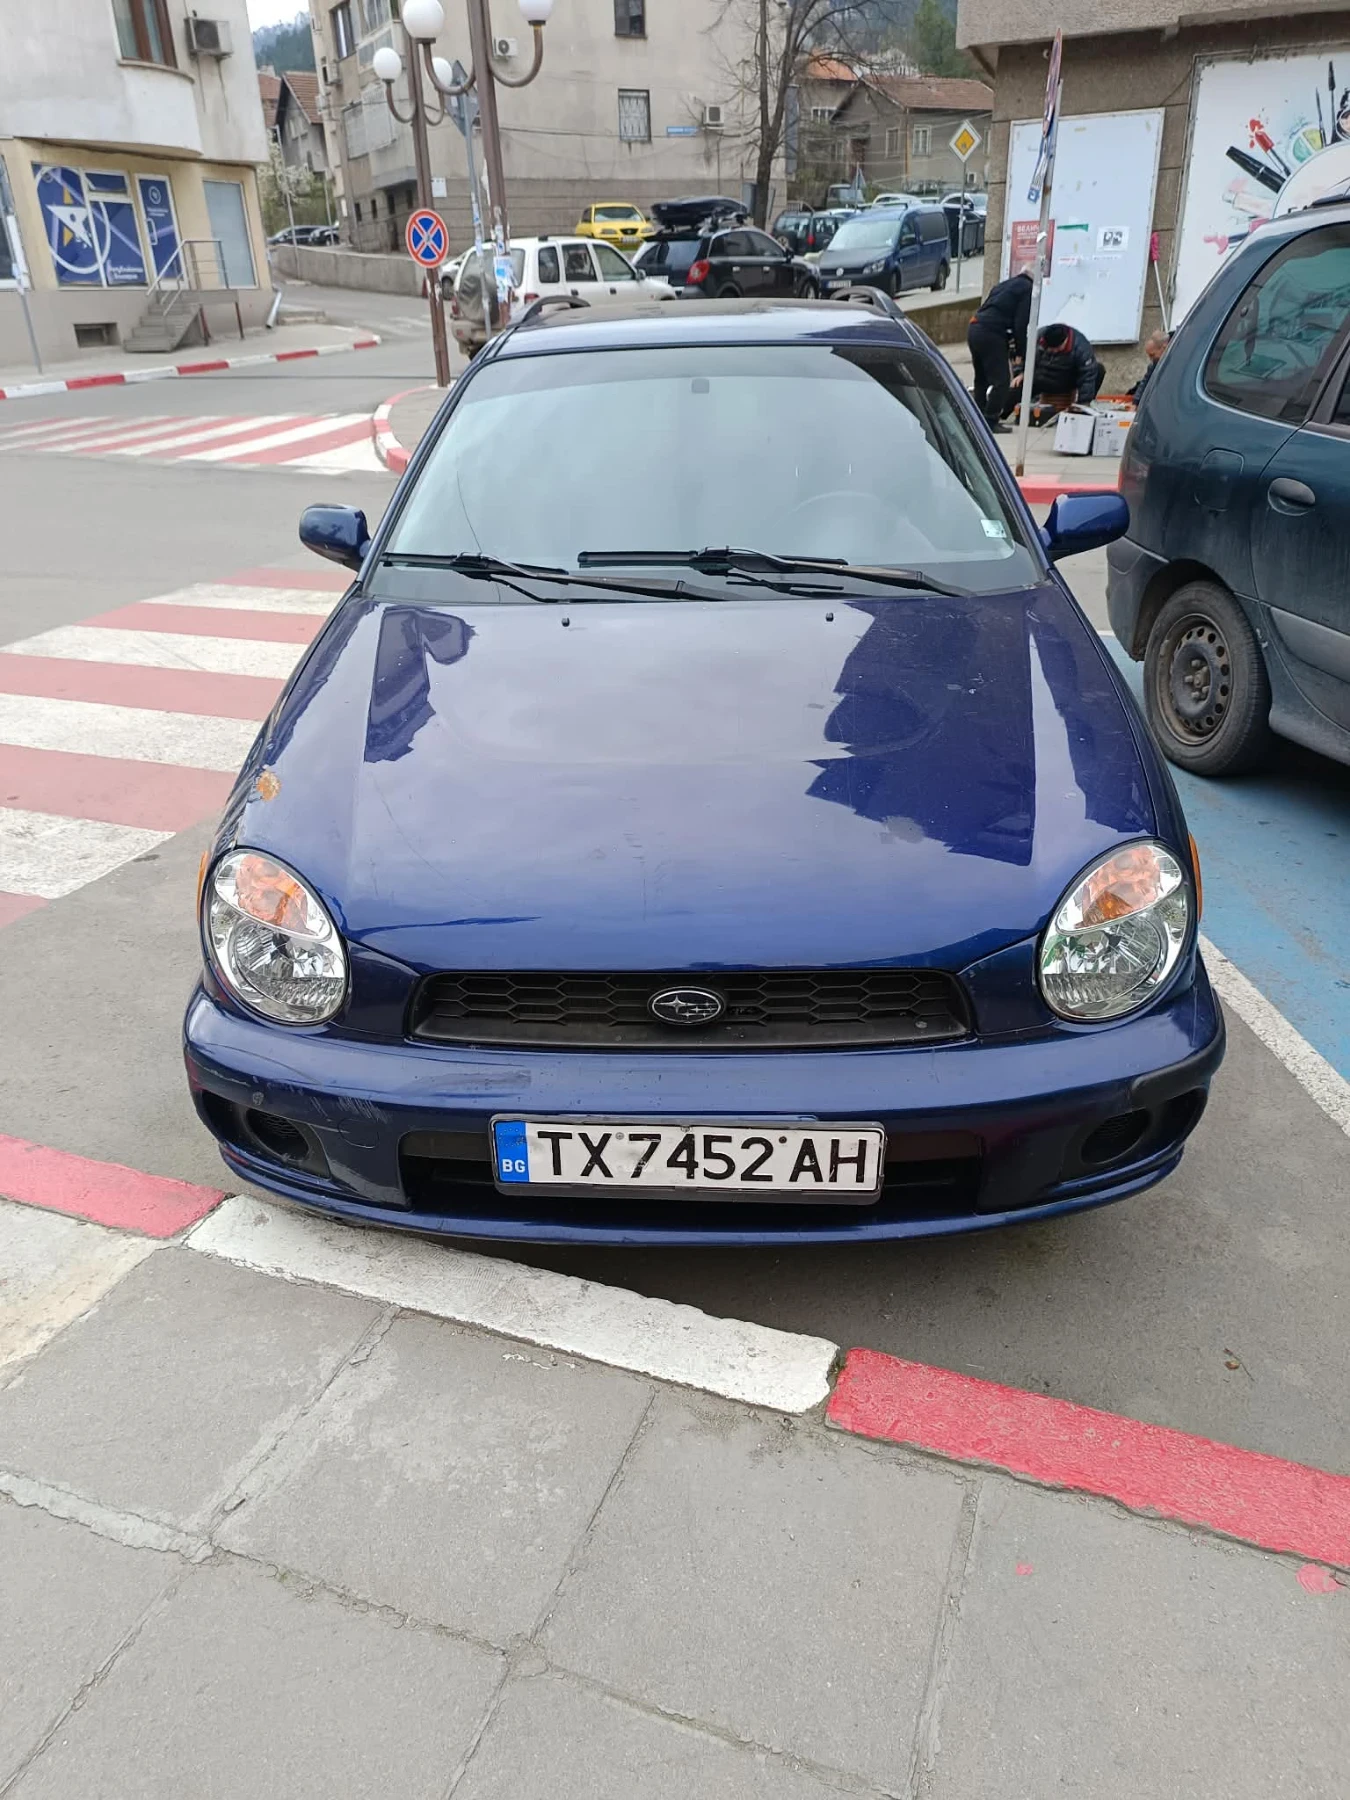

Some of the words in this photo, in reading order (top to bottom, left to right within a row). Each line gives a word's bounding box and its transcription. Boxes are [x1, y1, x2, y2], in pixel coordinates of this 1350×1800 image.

[502, 1159, 526, 1174] BG
[537, 1131, 614, 1178] TX
[628, 1133, 774, 1182] 7452
[789, 1138, 867, 1183] AH
